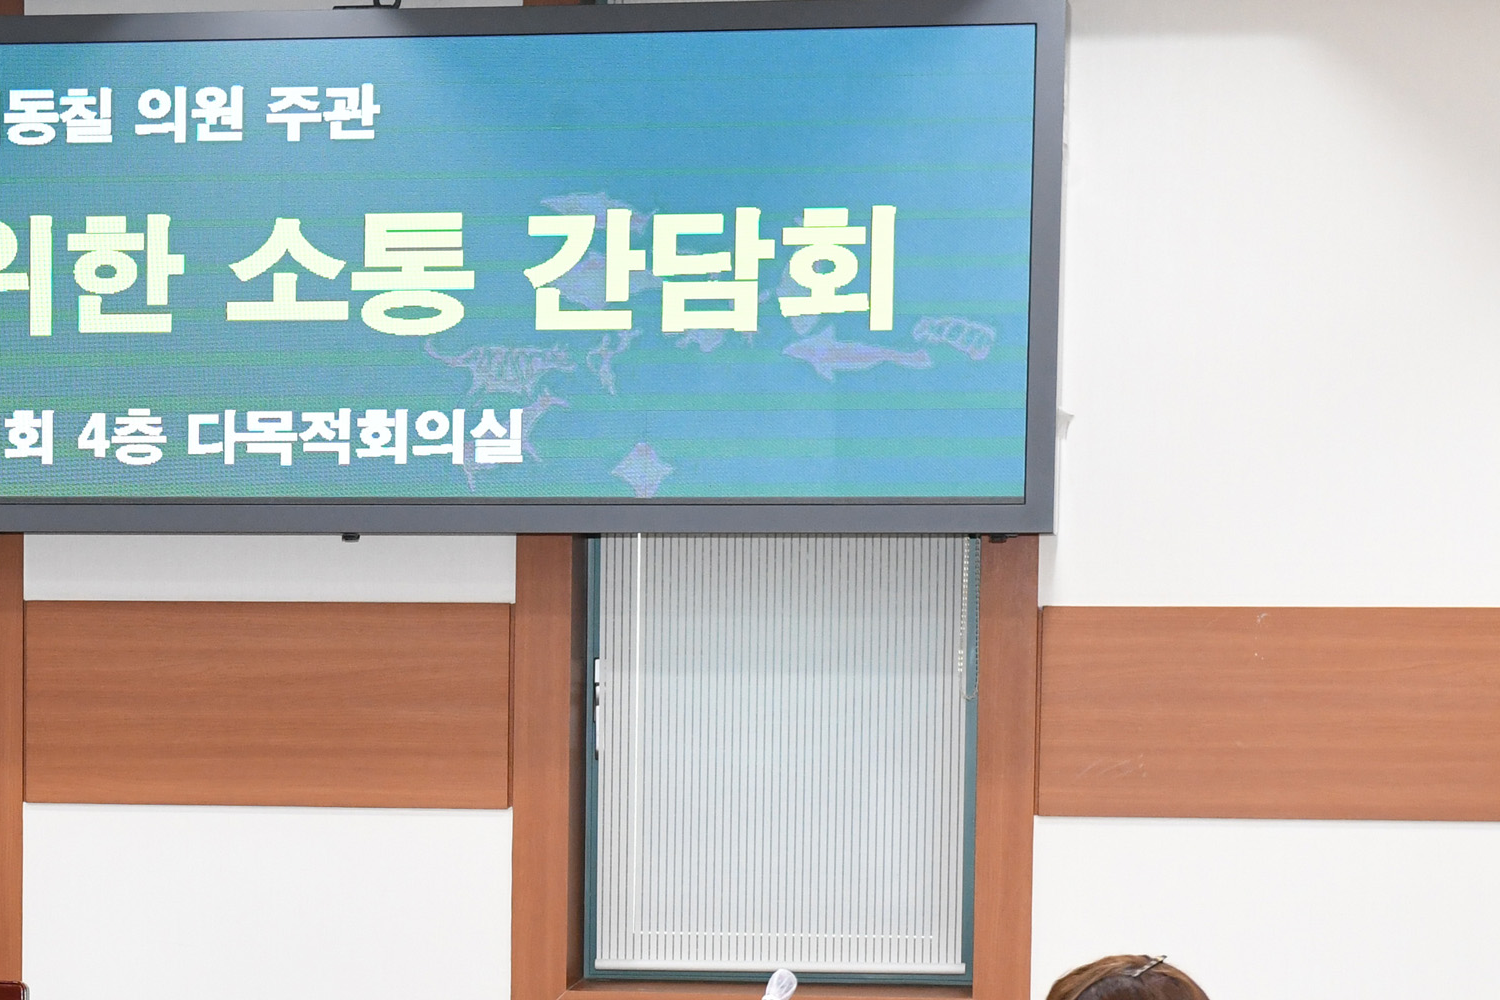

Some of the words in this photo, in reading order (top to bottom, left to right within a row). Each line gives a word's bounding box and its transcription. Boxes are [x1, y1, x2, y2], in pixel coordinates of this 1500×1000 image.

[134, 85, 245, 144] 의원
[265, 83, 381, 142] 주관
[225, 211, 476, 337] 소통
[522, 204, 898, 333] 간담회
[77, 408, 167, 466] 4층
[187, 406, 525, 467] 다목적회의실
